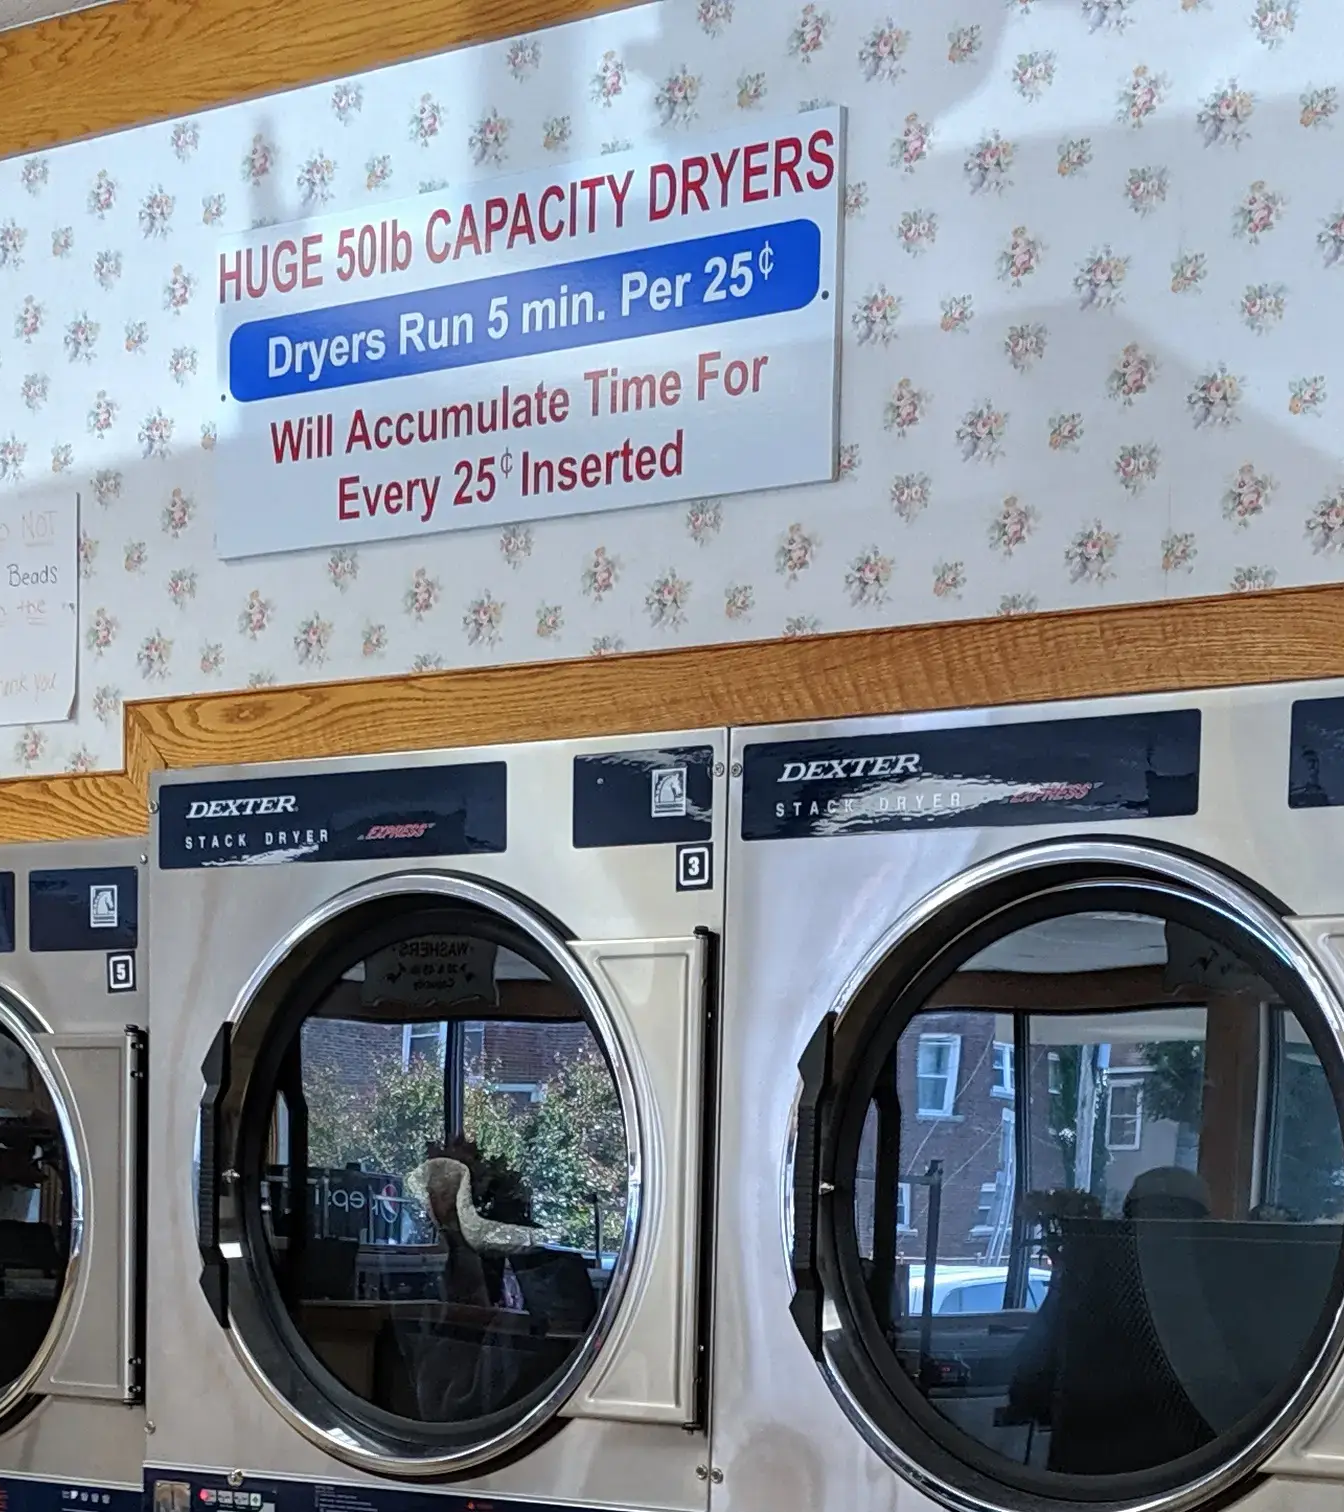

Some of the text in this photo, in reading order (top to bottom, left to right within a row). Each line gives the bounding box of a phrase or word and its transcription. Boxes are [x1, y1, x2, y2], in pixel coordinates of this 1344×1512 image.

[219, 129, 835, 304] HUGE 50lb CAPACITY DRYERS
[267, 323, 385, 383] Dryers
[398, 306, 473, 355] Run
[487, 295, 509, 341] 5
[521, 284, 605, 335] min.
[621, 270, 691, 318] Per
[271, 350, 768, 464] Will Accumulate Time For
[338, 473, 441, 523] Every
[521, 429, 684, 497] Inserted
[22, 510, 58, 541] NOT
[7, 564, 58, 588] Beads
[776, 753, 921, 782] DEXTER
[185, 795, 297, 819] DEXTER
[775, 792, 963, 818] STACK DRYER
[185, 829, 330, 850] STACK DRYER
[688, 856, 700, 877] 3
[116, 964, 126, 981] 5
